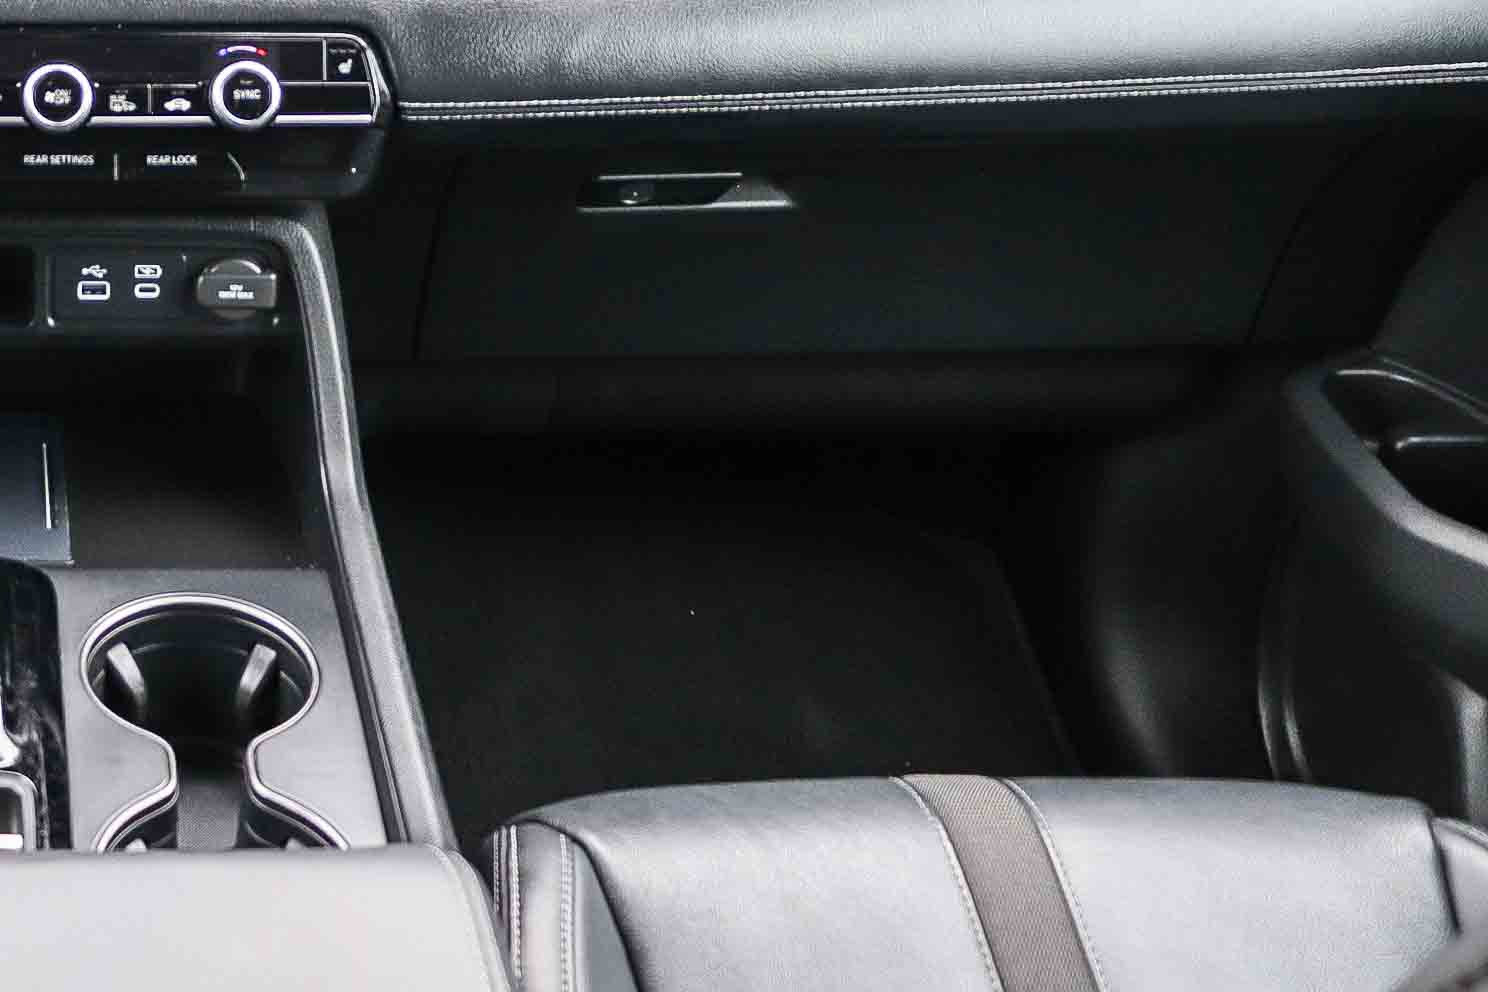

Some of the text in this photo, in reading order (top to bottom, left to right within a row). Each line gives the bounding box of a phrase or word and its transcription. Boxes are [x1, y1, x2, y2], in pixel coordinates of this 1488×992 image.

[232, 89, 261, 100] SYNC
[23, 155, 95, 166] REAR SETTINGS
[146, 155, 198, 166] REAR LOCK
